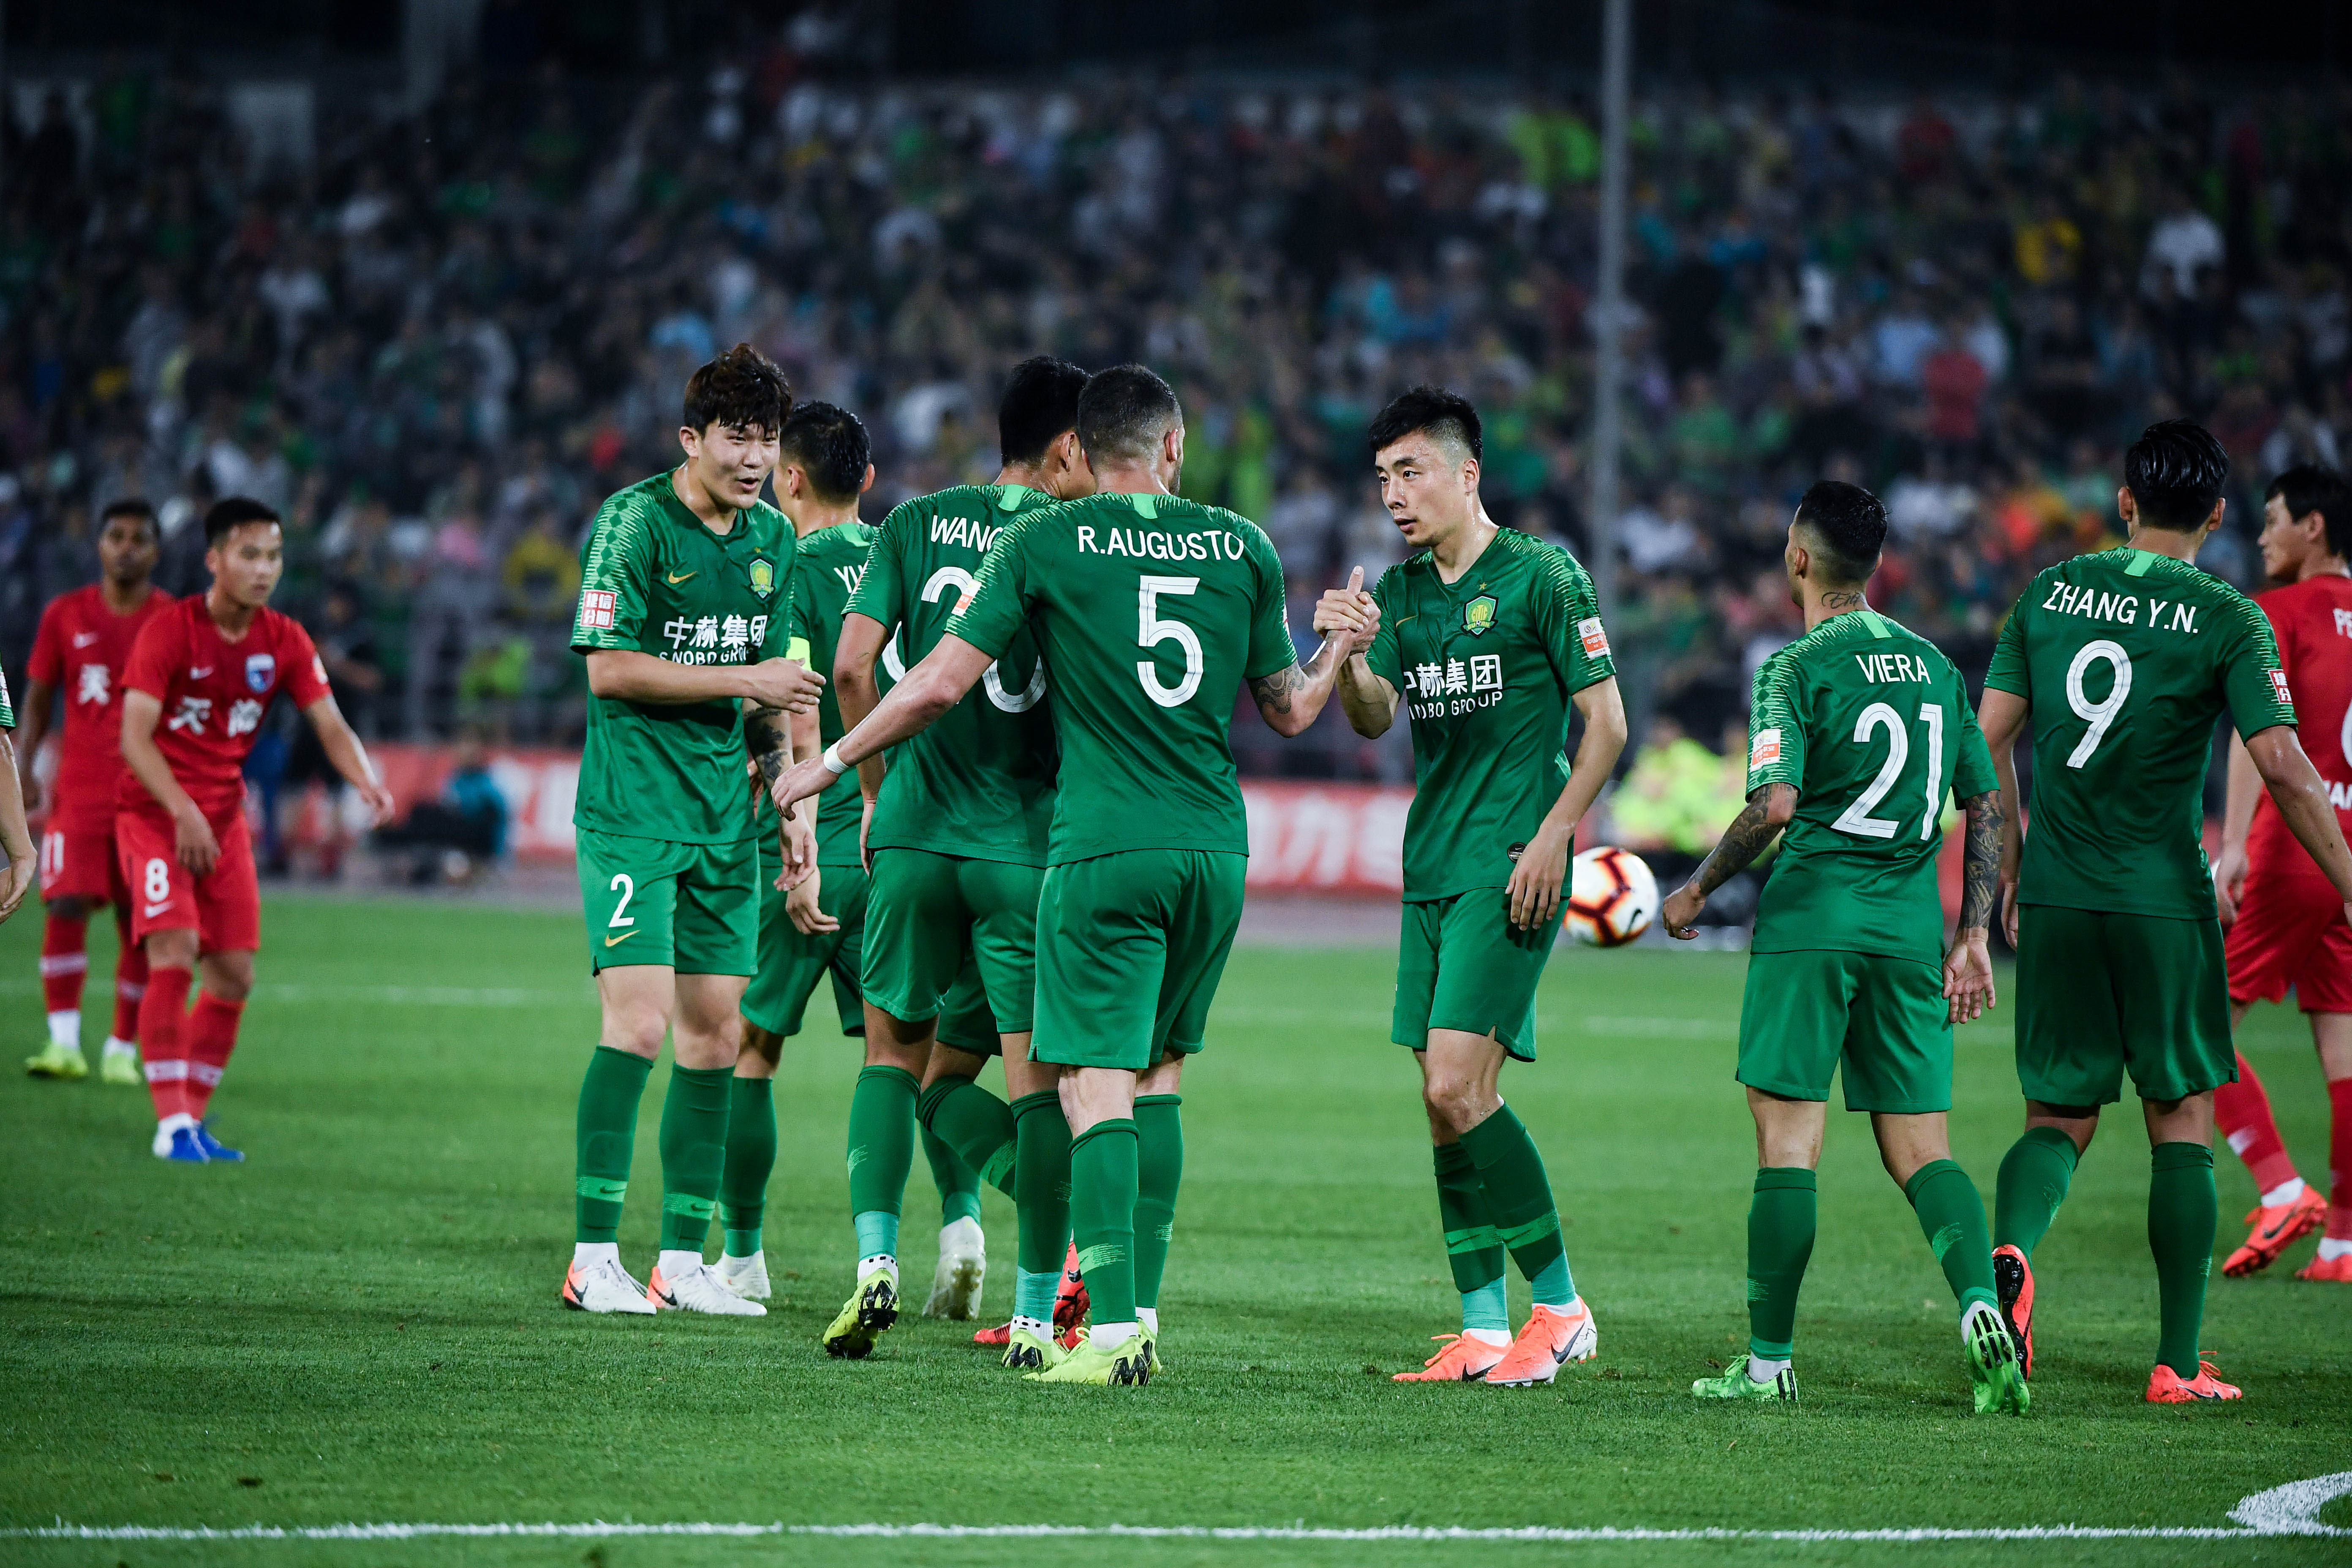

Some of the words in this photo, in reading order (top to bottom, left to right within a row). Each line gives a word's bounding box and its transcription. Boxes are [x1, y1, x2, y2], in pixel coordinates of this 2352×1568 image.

[1078, 525, 1244, 561] R.AUGUSTO
[664, 614, 768, 649] 中赫集团
[2042, 581, 2138, 624] ZHANG
[2148, 599, 2199, 634] Y.N.
[1137, 575, 1204, 708] 5
[1855, 654, 1931, 684] VIERA
[1451, 691, 1503, 716] GROUP
[2066, 640, 2132, 769] 9
[1830, 702, 1943, 841] 21
[145, 858, 170, 903] 8
[608, 873, 634, 928] 2
